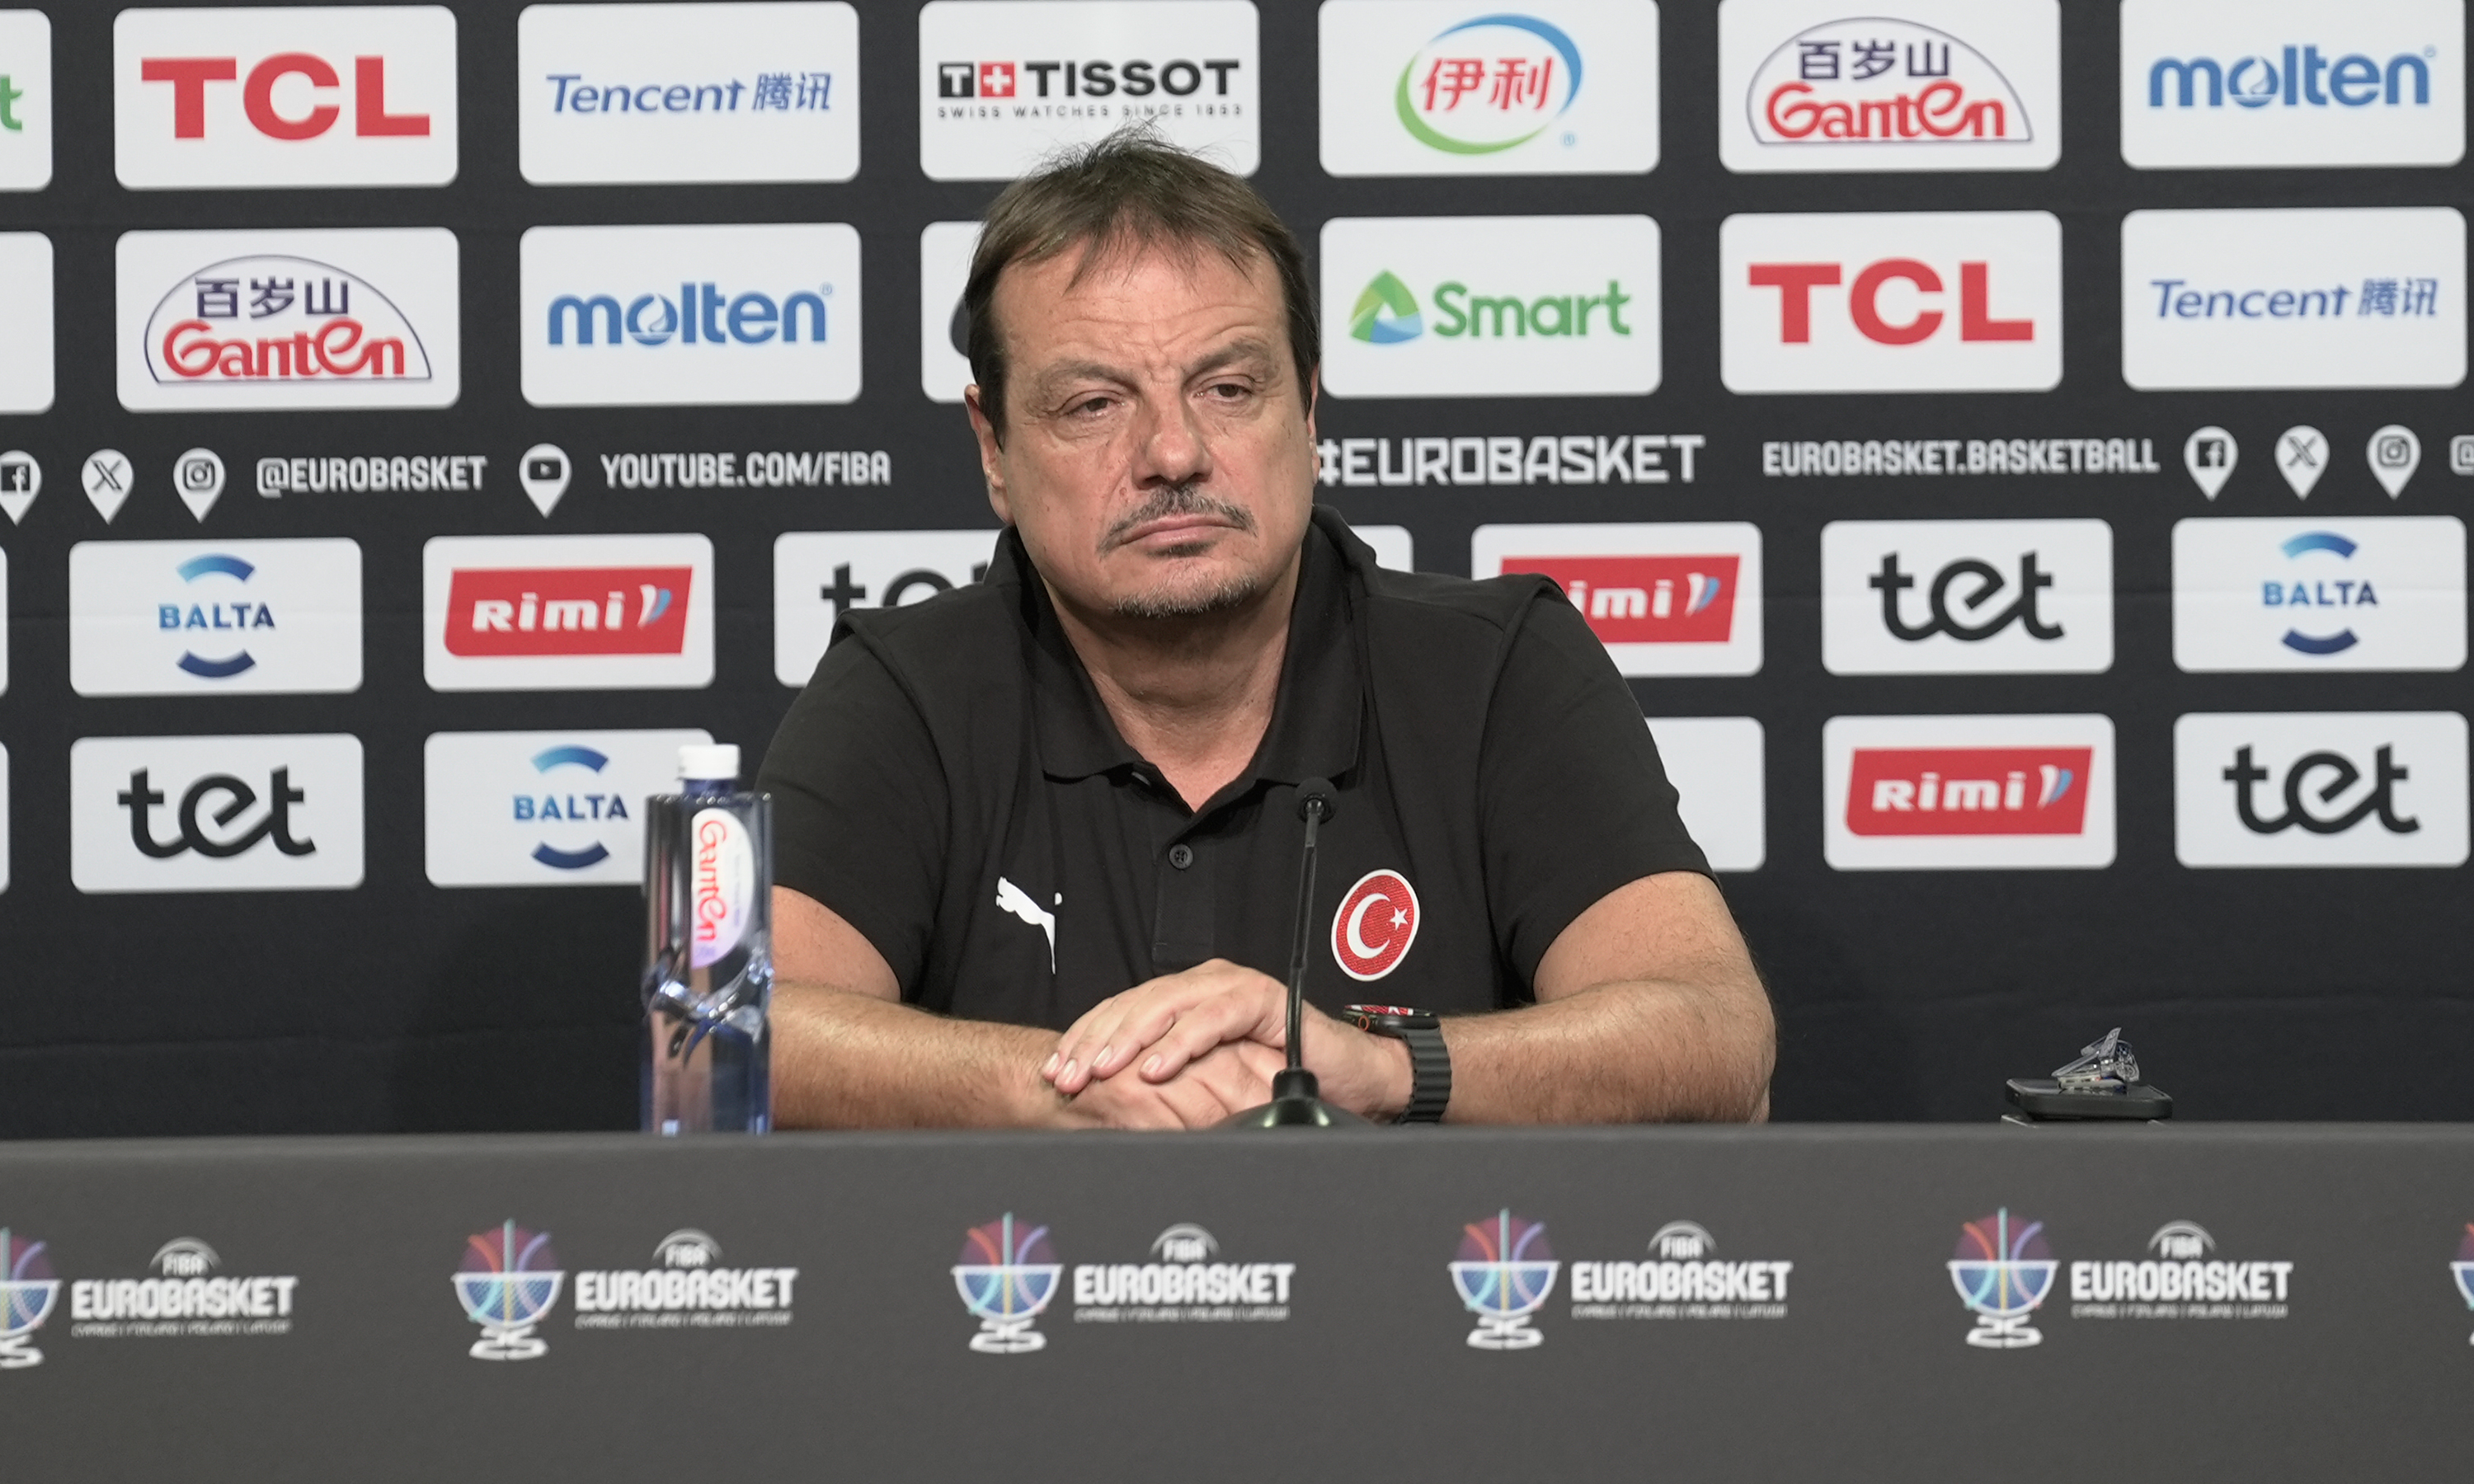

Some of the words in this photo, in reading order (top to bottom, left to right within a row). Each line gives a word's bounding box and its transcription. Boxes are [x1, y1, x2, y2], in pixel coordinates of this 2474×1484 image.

[1025, 60, 1239, 97] TISSOT
[1799, 39, 1951, 81] 百岁山
[2149, 45, 2429, 109] molten
[141, 53, 430, 141] TCL
[547, 75, 745, 113] Tencent
[752, 73, 830, 110] 腾讯
[1424, 58, 1552, 110] 伊利
[938, 107, 999, 118] SWISS
[1014, 106, 1108, 118] WATCHES
[1122, 105, 1183, 116] SINCE
[1197, 105, 1241, 116] 1853
[195, 277, 350, 318] 百岁山
[548, 283, 825, 346] molten
[1433, 280, 1631, 338] Smart
[1748, 259, 2034, 345] TCL
[2152, 280, 2350, 318] Tencent
[2358, 279, 2438, 316] 腾讯
[257, 456, 487, 497] @EUROBASKET
[601, 451, 890, 487] YOUTUBE.COM/FIBA
[1317, 435, 1705, 486] #EUROBASKET
[1763, 439, 2160, 476] EUROBASKET.BASKETBALL
[473, 592, 624, 631] Rimi
[1569, 580, 1673, 618] imi
[1869, 551, 2065, 642] tet
[2263, 581, 2378, 606] BALTA
[159, 603, 275, 629] BALTA
[515, 795, 628, 820] BALTA
[1873, 772, 2025, 810] Rimi
[2222, 744, 2420, 835] tet
[118, 766, 316, 859] tet
[72, 1277, 298, 1319] EUROBASKET
[575, 1267, 799, 1311] EUROBASKET
[1075, 1264, 1295, 1304] EUROBASKET
[1571, 1261, 1793, 1301] EUROBASKET
[2071, 1261, 2293, 1301] EUROBASKET
